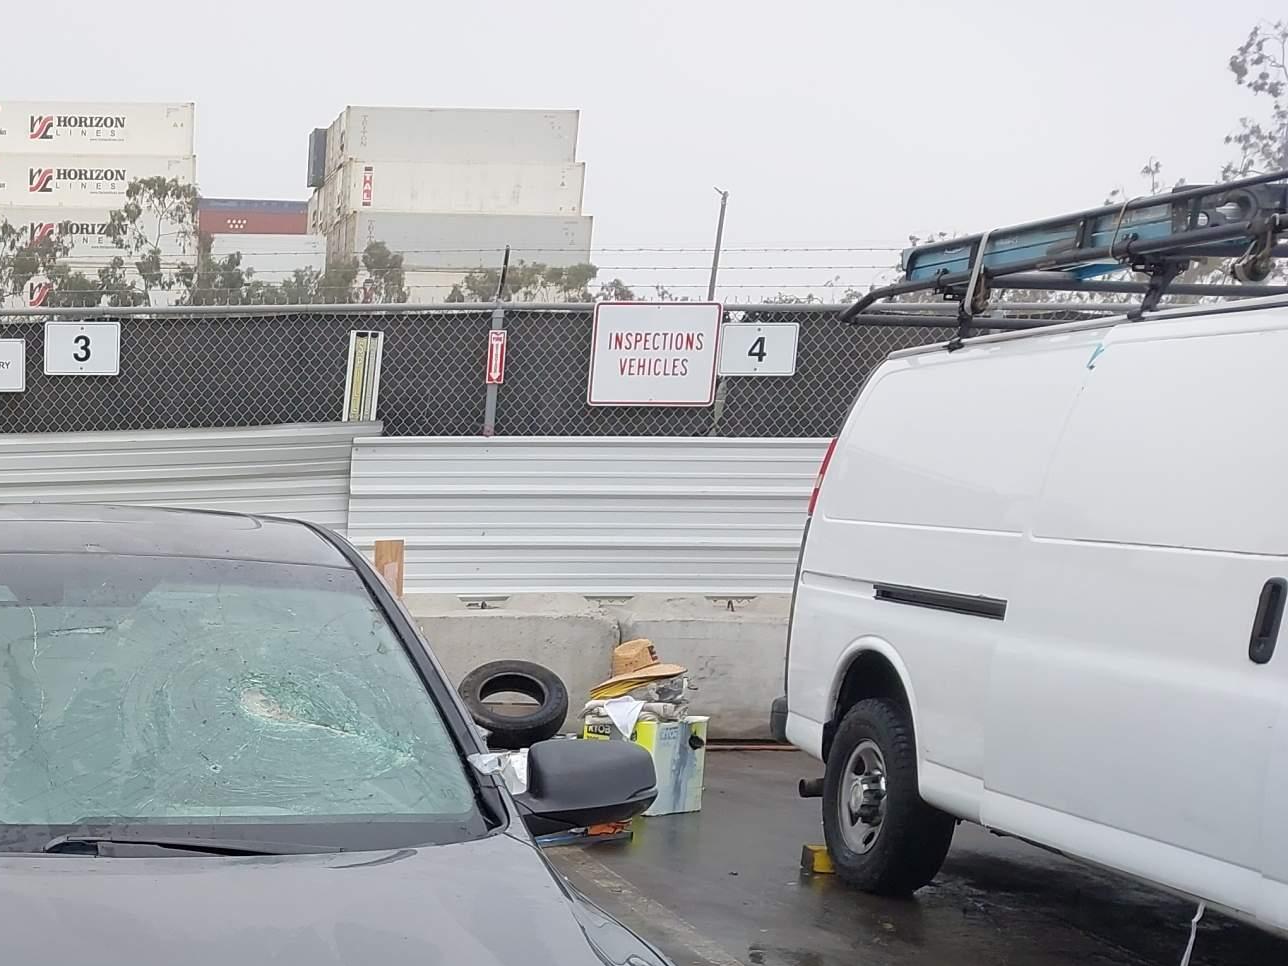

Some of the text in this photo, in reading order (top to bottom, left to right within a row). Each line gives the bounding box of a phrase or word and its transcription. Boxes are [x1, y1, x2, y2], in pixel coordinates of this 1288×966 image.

[56, 116, 126, 128] HORIZON
[56, 129, 116, 137] LINES
[56, 168, 126, 181] HORIZON
[56, 182, 116, 190] LINES
[58, 222, 128, 236] HORIZN
[73, 335, 91, 362] 3
[608, 333, 704, 350] INSPECTIONS
[748, 337, 766, 362] 4
[619, 358, 689, 376] VEHICLES
